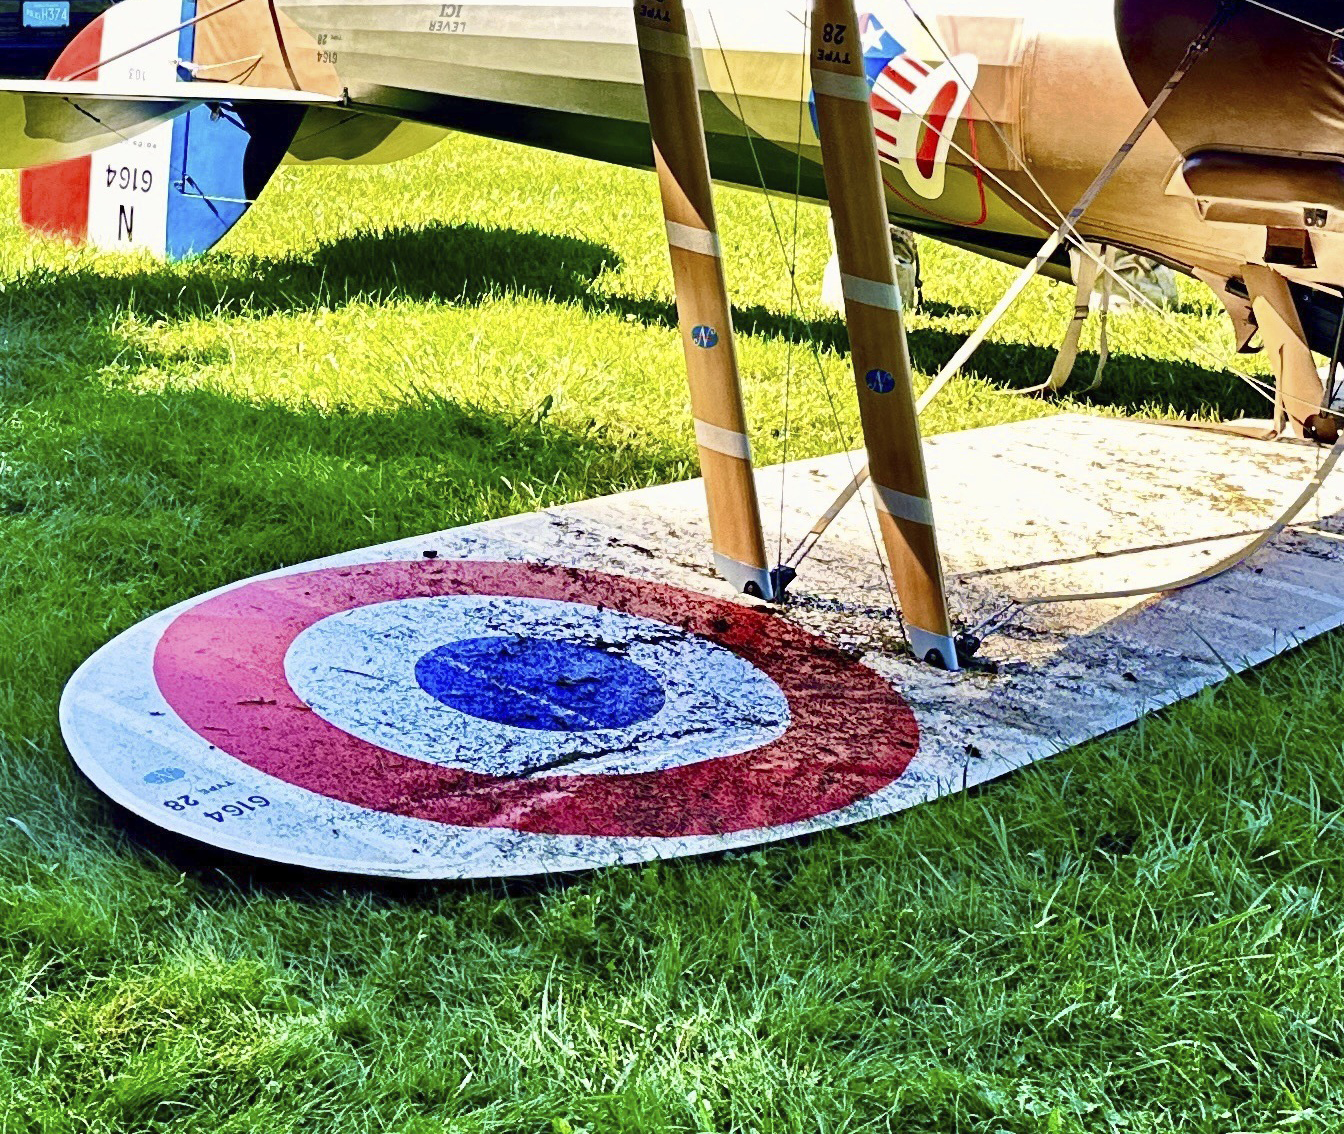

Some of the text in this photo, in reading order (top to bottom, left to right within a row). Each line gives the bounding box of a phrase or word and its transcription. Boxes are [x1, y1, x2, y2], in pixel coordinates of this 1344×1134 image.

[41, 7, 68, 21] H374
[439, 4, 464, 18] ICI
[640, 5, 671, 23] TYPE
[428, 21, 467, 33] LEVER
[822, 22, 847, 45] 28
[316, 51, 338, 64] 6164
[816, 47, 851, 65] TYPE
[105, 165, 153, 193] 6164
[118, 204, 134, 242] N
[163, 794, 199, 811] 28
[203, 795, 270, 823] 6164
